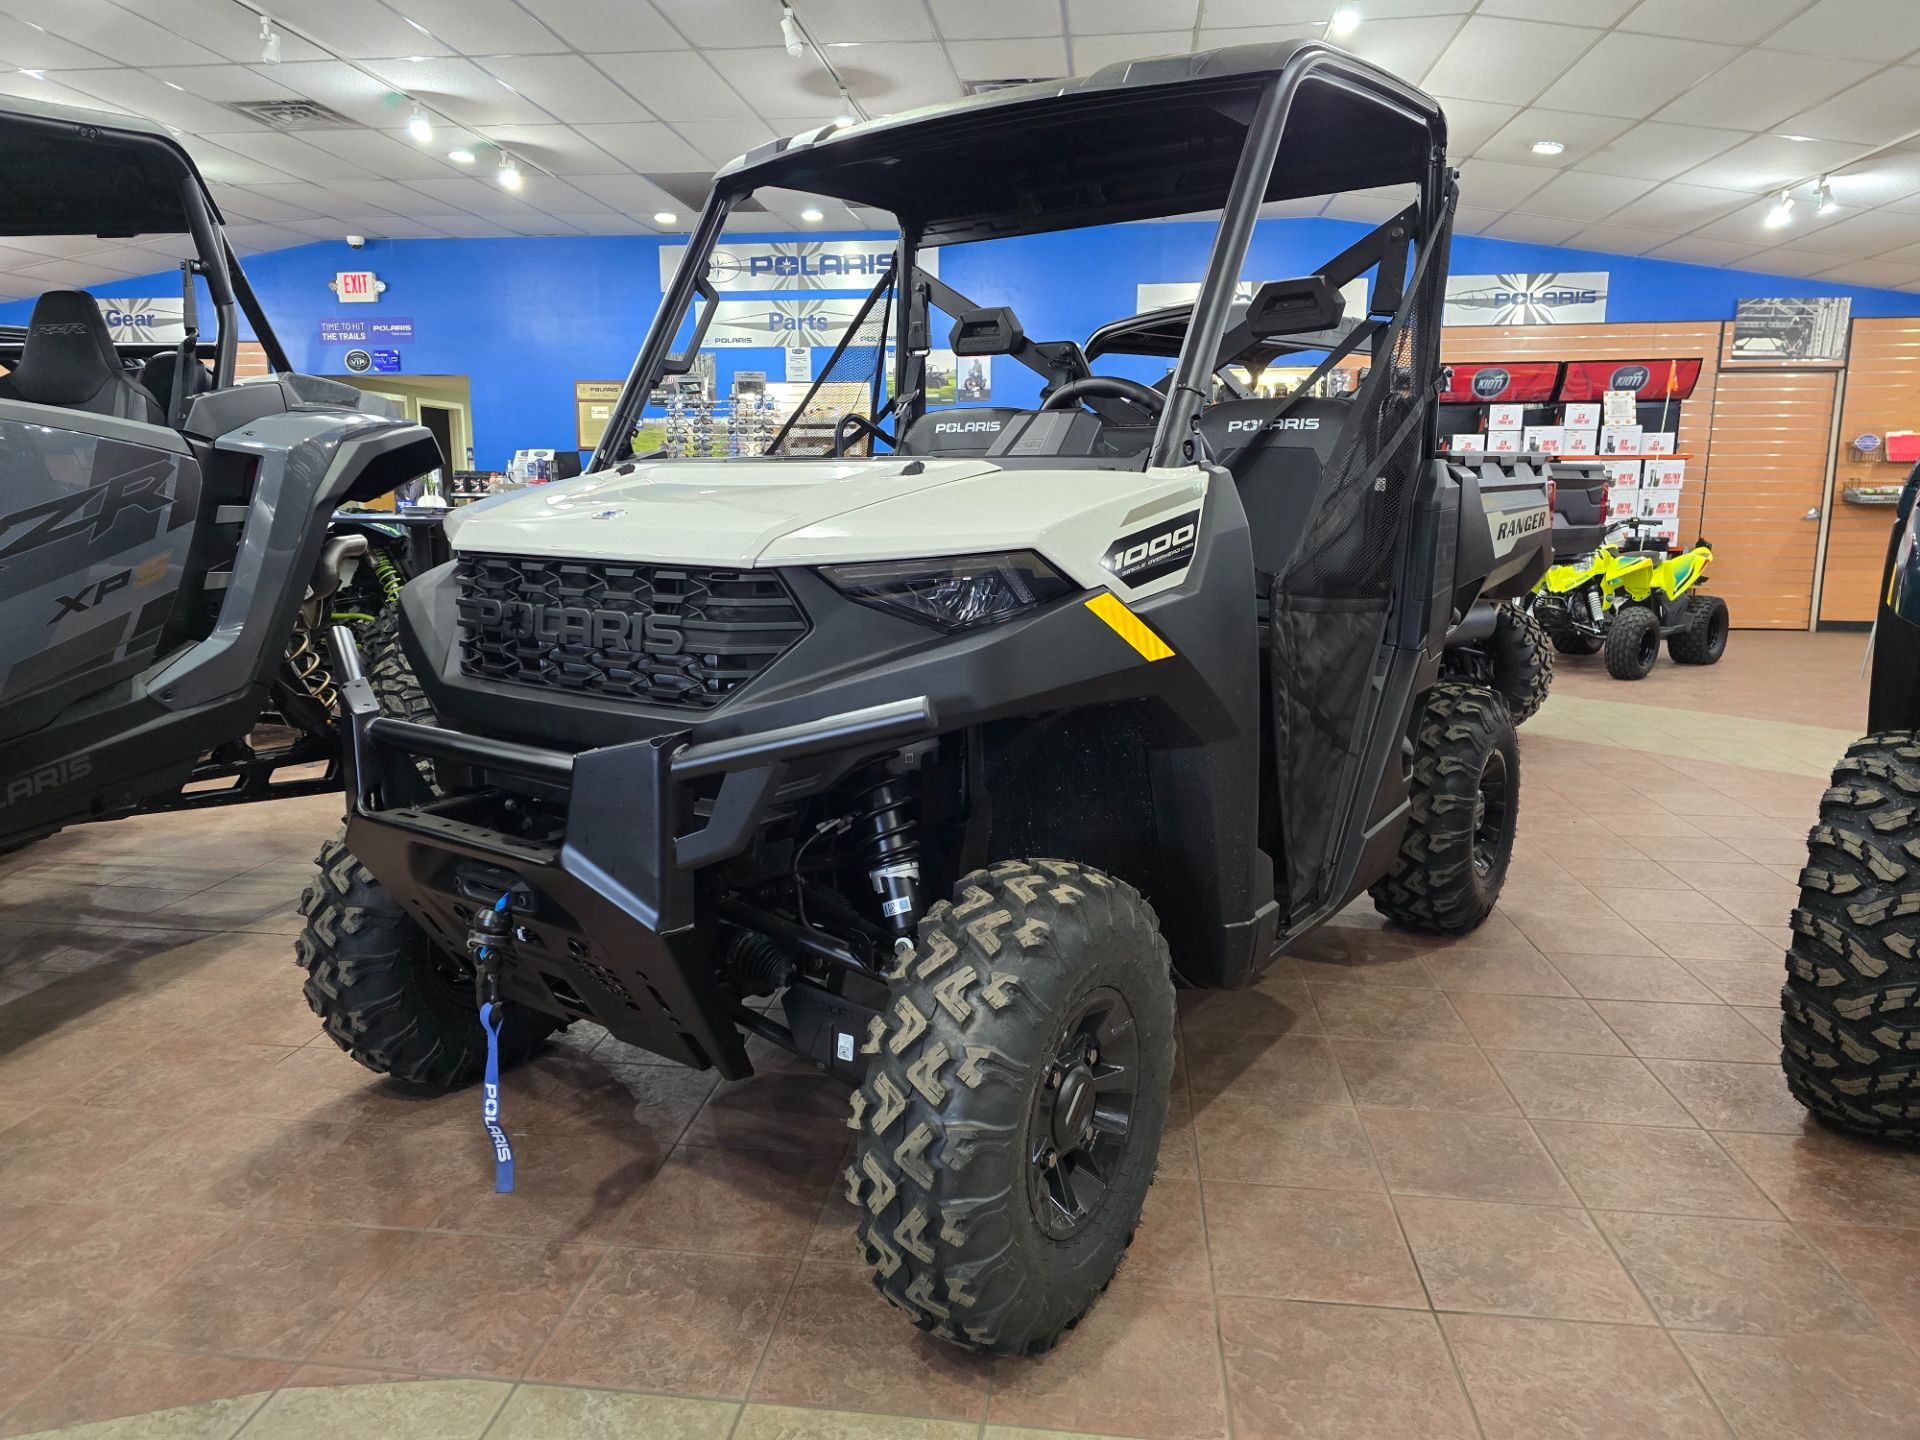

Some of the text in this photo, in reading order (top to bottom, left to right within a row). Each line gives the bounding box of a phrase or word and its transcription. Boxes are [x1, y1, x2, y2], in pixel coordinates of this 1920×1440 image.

[750, 254, 893, 277] POLARIS
[343, 274, 367, 294] EXIT
[1494, 290, 1597, 306] POLARIS
[106, 309, 155, 327] Gear
[321, 322, 365, 331] TIME TO HIT
[769, 311, 829, 333] Parts
[322, 332, 366, 341] THE TRAILS
[714, 336, 753, 344] POLARIS
[1477, 375, 1504, 389] KIOTI
[1615, 371, 1644, 387] KIOTI
[935, 421, 1001, 434] POLARIS
[0, 459, 178, 561] ZR
[1497, 511, 1547, 541] RANGER
[1114, 523, 1195, 571] 1000
[1121, 563, 1146, 577] SINGLE
[1147, 548, 1181, 566] OVERHEAD
[46, 568, 133, 627] XP
[478, 598, 686, 655] POLARIS
[0, 753, 93, 808] ARIS
[484, 1083, 512, 1163] POLARIS
